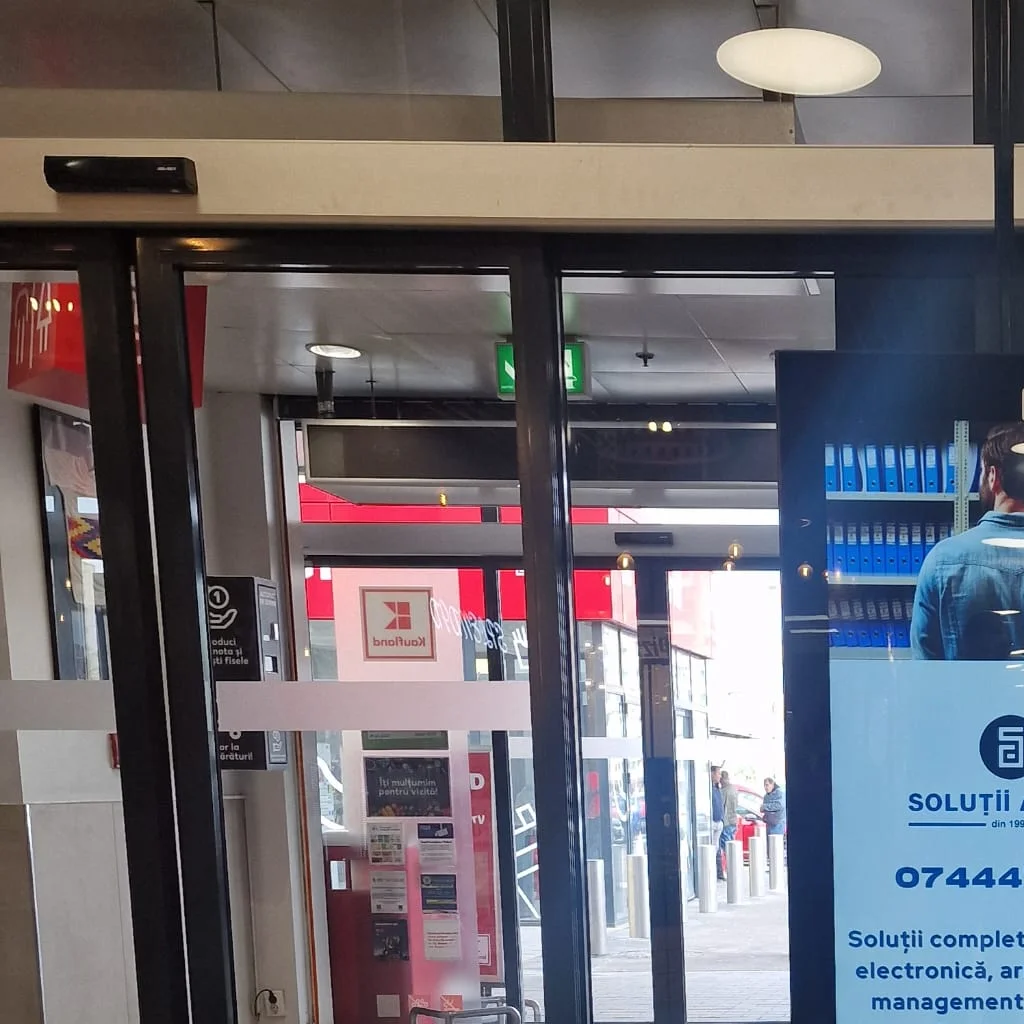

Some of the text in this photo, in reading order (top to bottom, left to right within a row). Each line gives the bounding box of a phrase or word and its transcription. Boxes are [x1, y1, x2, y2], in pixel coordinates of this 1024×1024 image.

[212, 637, 236, 646] oduci
[220, 752, 253, 761] ărături!
[991, 820, 1006, 828] din
[848, 930, 923, 954] Soluții
[855, 961, 993, 982] electronică,
[871, 993, 1024, 1015] management
